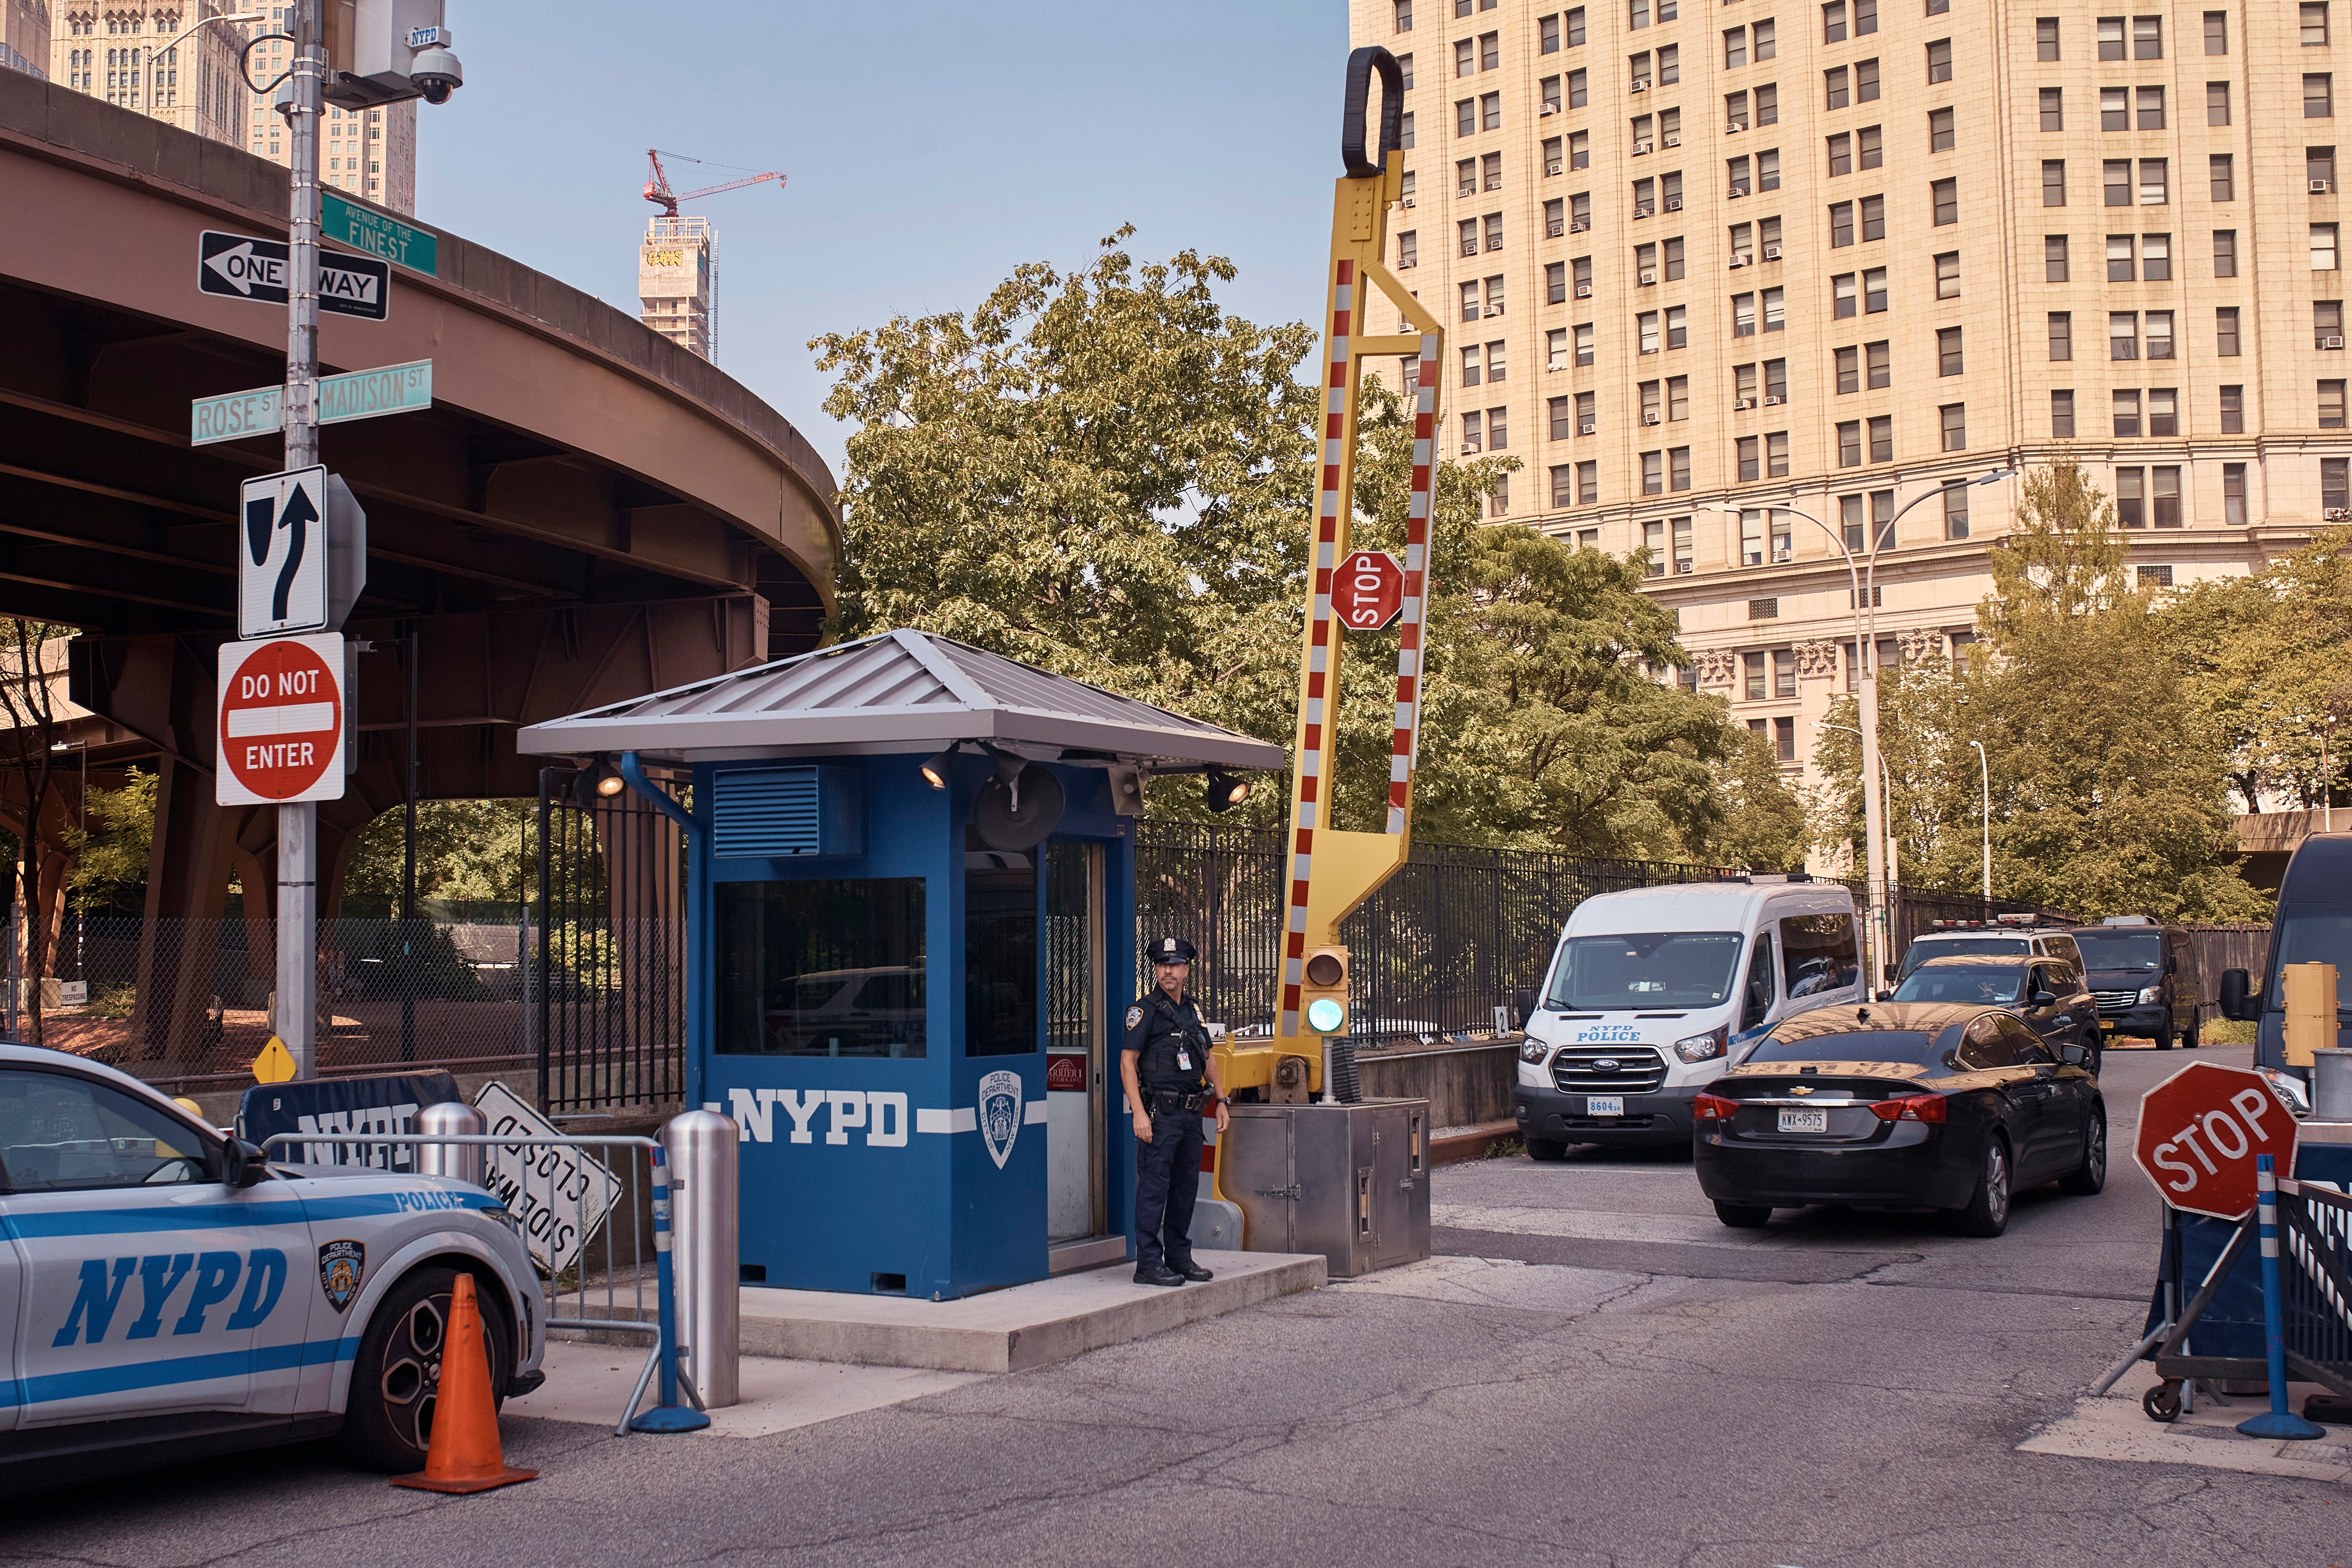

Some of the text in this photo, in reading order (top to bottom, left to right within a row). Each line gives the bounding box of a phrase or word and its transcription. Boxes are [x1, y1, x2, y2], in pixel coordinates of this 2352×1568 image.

[412, 28, 437, 45] NYPD
[345, 206, 412, 241] AVENUE OF THE
[349, 221, 408, 263] FINEST
[227, 255, 372, 298] ONE WAY
[323, 368, 425, 418] MADISON ST
[198, 392, 278, 438] ROSE ST
[1352, 556, 1381, 625] STOP
[242, 669, 319, 699] DO NOT
[246, 742, 314, 770] ENTER
[62, 993, 86, 1002] TRESPASSING
[1500, 1012, 1505, 1033] 2
[1576, 1032, 1641, 1042] POLICE
[990, 1073, 1010, 1084] POLICE
[1047, 1068, 1077, 1077] ARRIER
[982, 1083, 1019, 1101] DEPARTMENT
[728, 1088, 908, 1147] NYPD
[987, 1138, 994, 1150] OF
[1006, 1130, 1015, 1153] NEW
[2152, 1088, 2269, 1193] STOP
[492, 1115, 590, 1202] CLOSED
[393, 1191, 463, 1212] POLICE
[322, 1250, 362, 1265] DEPARTMENT
[330, 1242, 353, 1251] POLICE
[354, 1266, 363, 1283] YORK
[51, 1248, 287, 1348] NYPD
[326, 1290, 334, 1299] OF
